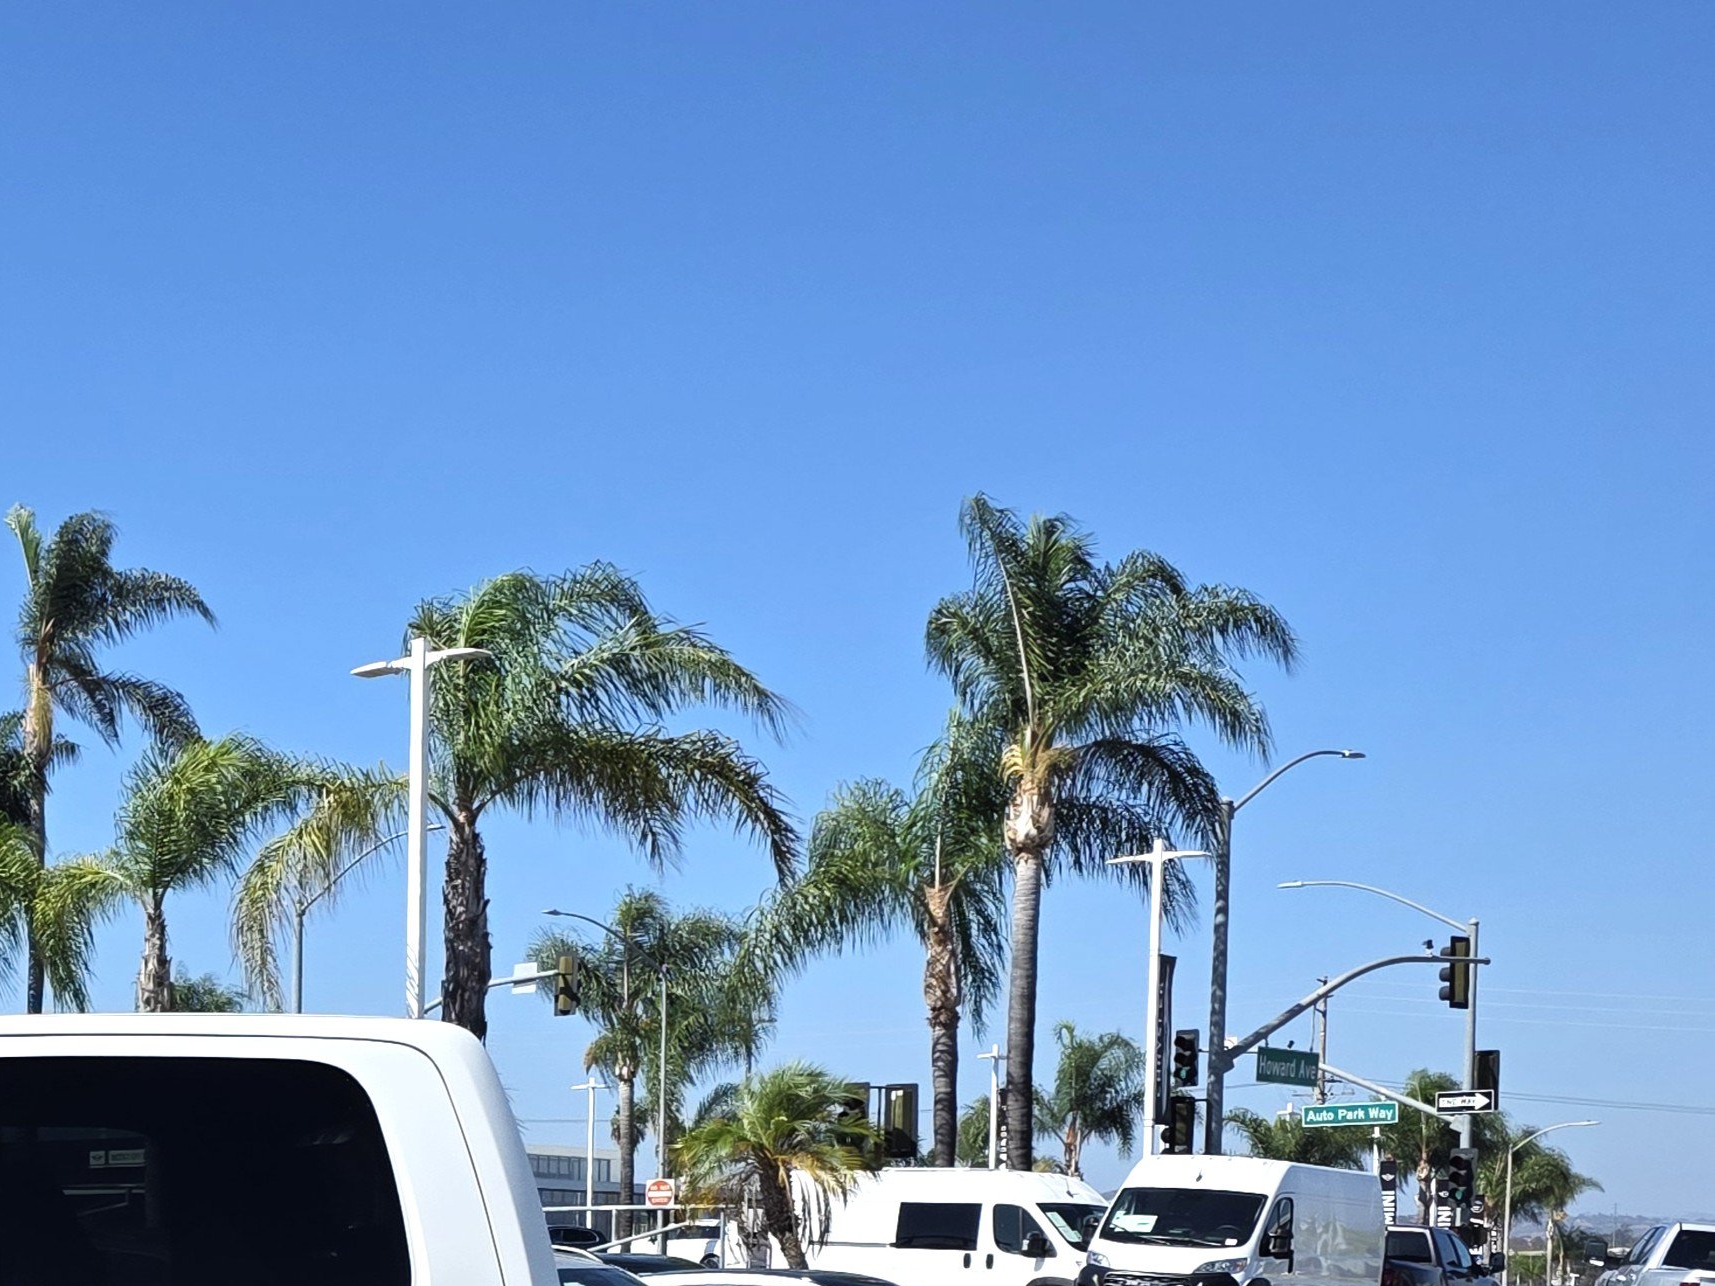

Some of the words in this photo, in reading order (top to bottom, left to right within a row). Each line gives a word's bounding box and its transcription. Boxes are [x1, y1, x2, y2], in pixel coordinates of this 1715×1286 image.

[1259, 1055, 1296, 1078] Howard
[1298, 1060, 1317, 1079] Ave
[1306, 1110, 1335, 1122] Auto
[1338, 1108, 1365, 1121] Park
[1368, 1107, 1394, 1121] Way
[1381, 1190, 1396, 1225] MINI
[1437, 1206, 1452, 1227] INI
